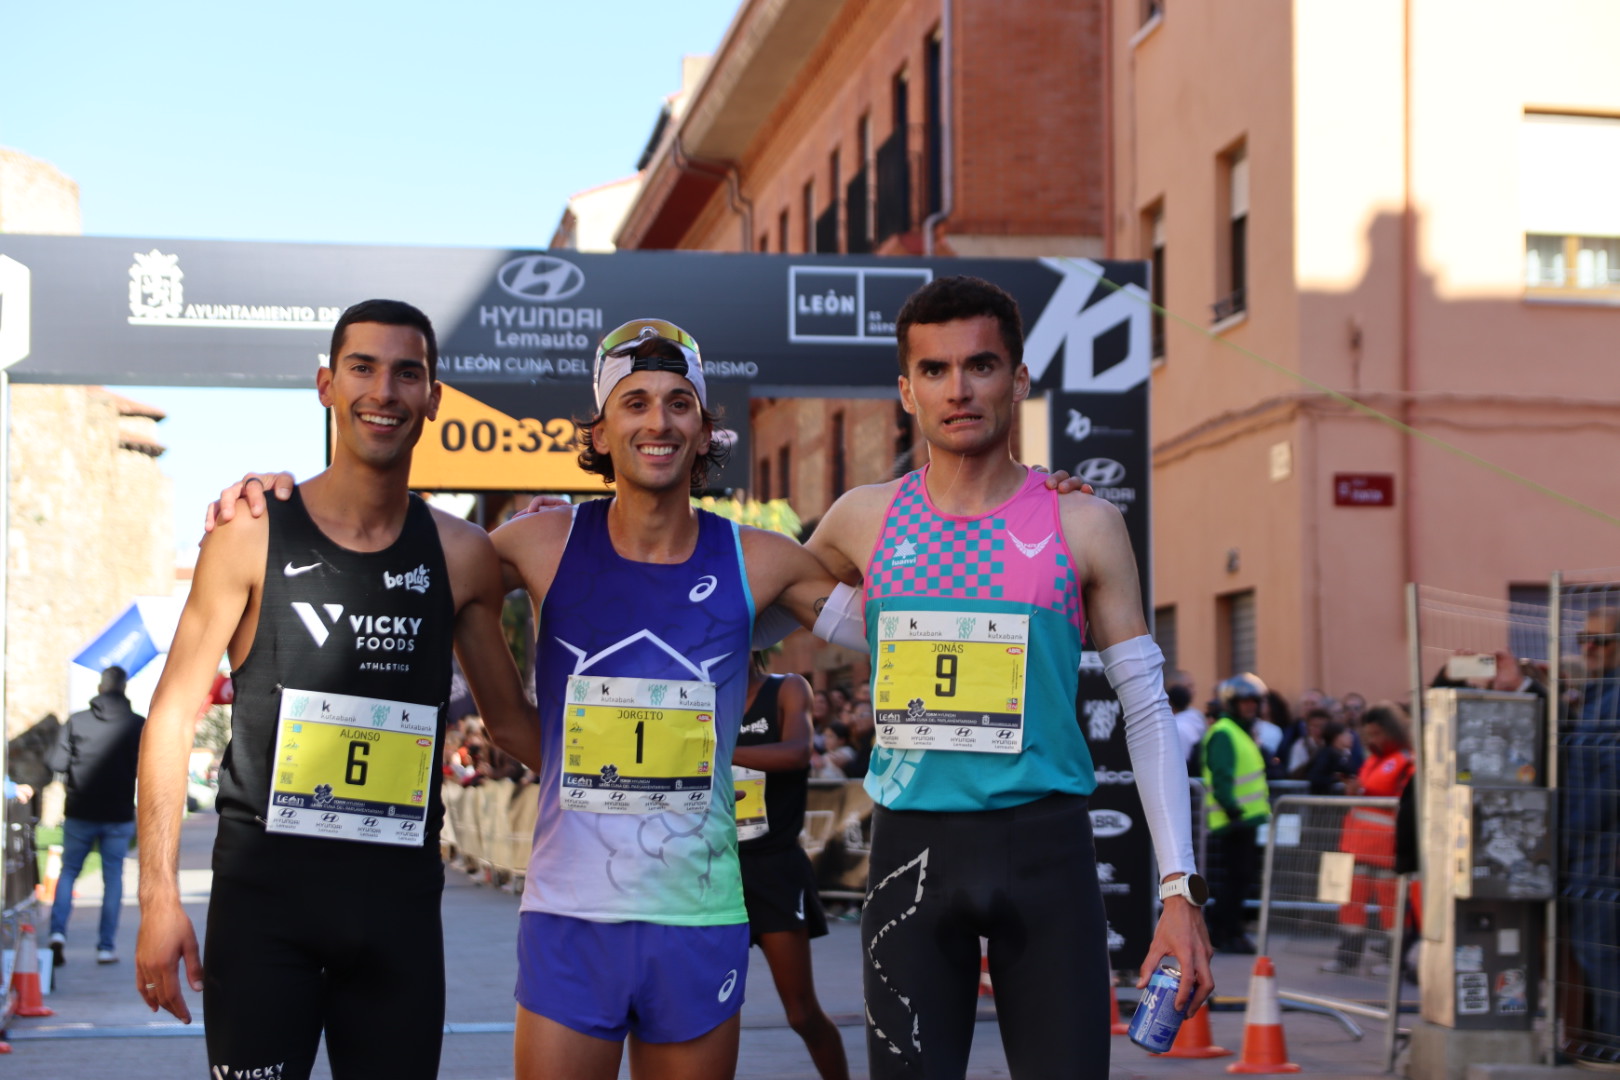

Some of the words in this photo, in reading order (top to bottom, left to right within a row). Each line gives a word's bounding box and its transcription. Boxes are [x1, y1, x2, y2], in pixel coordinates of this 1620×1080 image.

[184, 303, 316, 321] AYUNTAMIENTO
[318, 307, 341, 322] DE
[480, 305, 604, 329] HYUNDAI
[495, 329, 589, 349] Lemauto
[454, 354, 500, 372] LEÓN
[504, 357, 554, 374] CUNA
[558, 359, 590, 375] DEL
[702, 361, 759, 377] RISMO
[440, 418, 576, 452] 00:32
[349, 615, 422, 635] VICKY
[910, 617, 918, 630] k
[988, 620, 997, 632] k
[355, 637, 415, 651] FOODS
[931, 642, 964, 654] JONÁS
[359, 662, 410, 672] ATHLETICS
[935, 654, 958, 697] 9
[601, 684, 610, 696] k
[680, 687, 688, 700] k
[322, 700, 330, 712] k
[600, 696, 635, 704] kutxabank
[679, 700, 711, 708] kutxabank
[320, 712, 357, 722] kutxabank
[401, 709, 410, 722] k
[617, 710, 664, 720] JORGITO
[400, 722, 432, 732] kutxabank
[340, 728, 381, 742] ALONSO
[634, 721, 644, 764] 1
[344, 740, 370, 786] 6
[234, 1062, 285, 1080] VICKY
